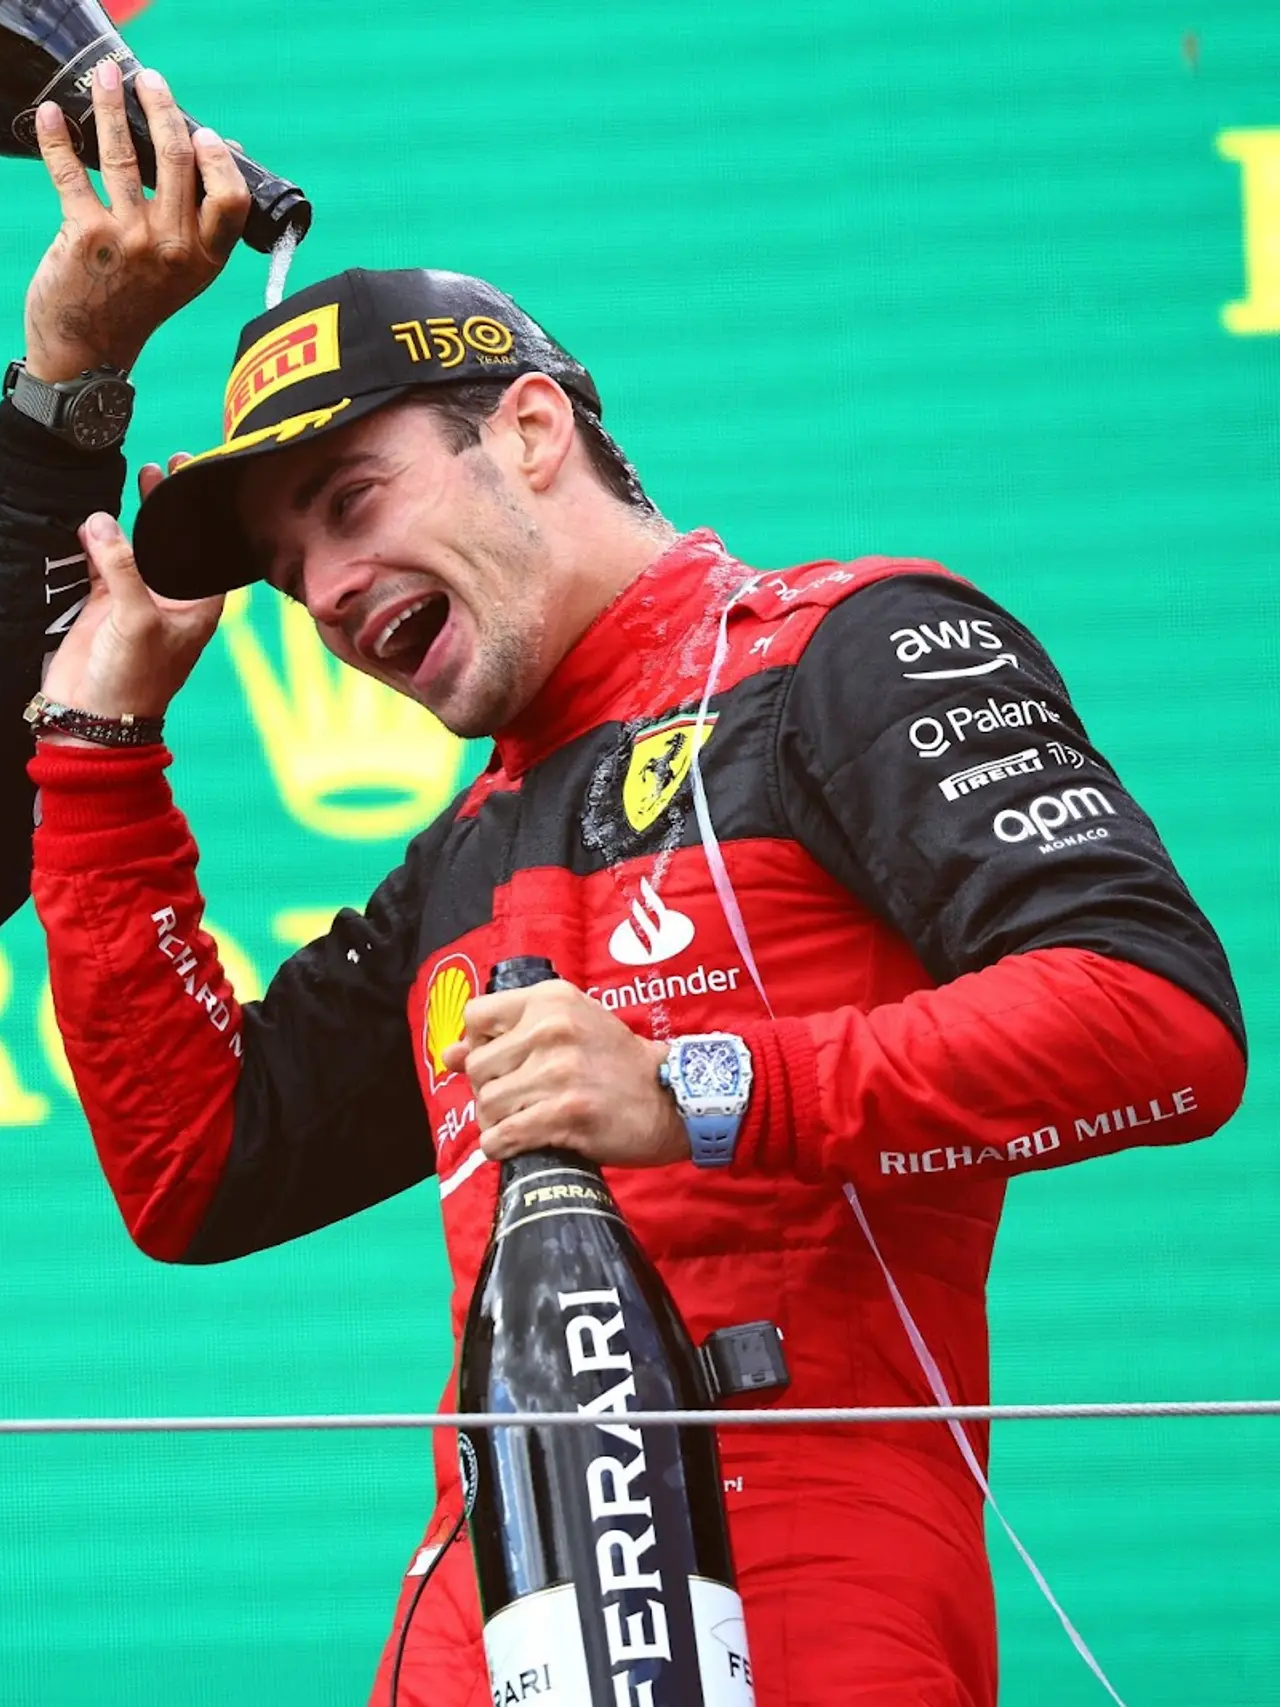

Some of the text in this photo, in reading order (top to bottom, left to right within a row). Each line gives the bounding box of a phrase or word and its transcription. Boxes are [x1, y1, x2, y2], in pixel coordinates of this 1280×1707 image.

[889, 619, 1003, 663] aws
[938, 747, 1044, 802] PIRELLI
[993, 786, 1117, 843] apm
[1039, 828, 1109, 854] MONACO
[879, 1086, 1198, 1176] RICHARD MILLE
